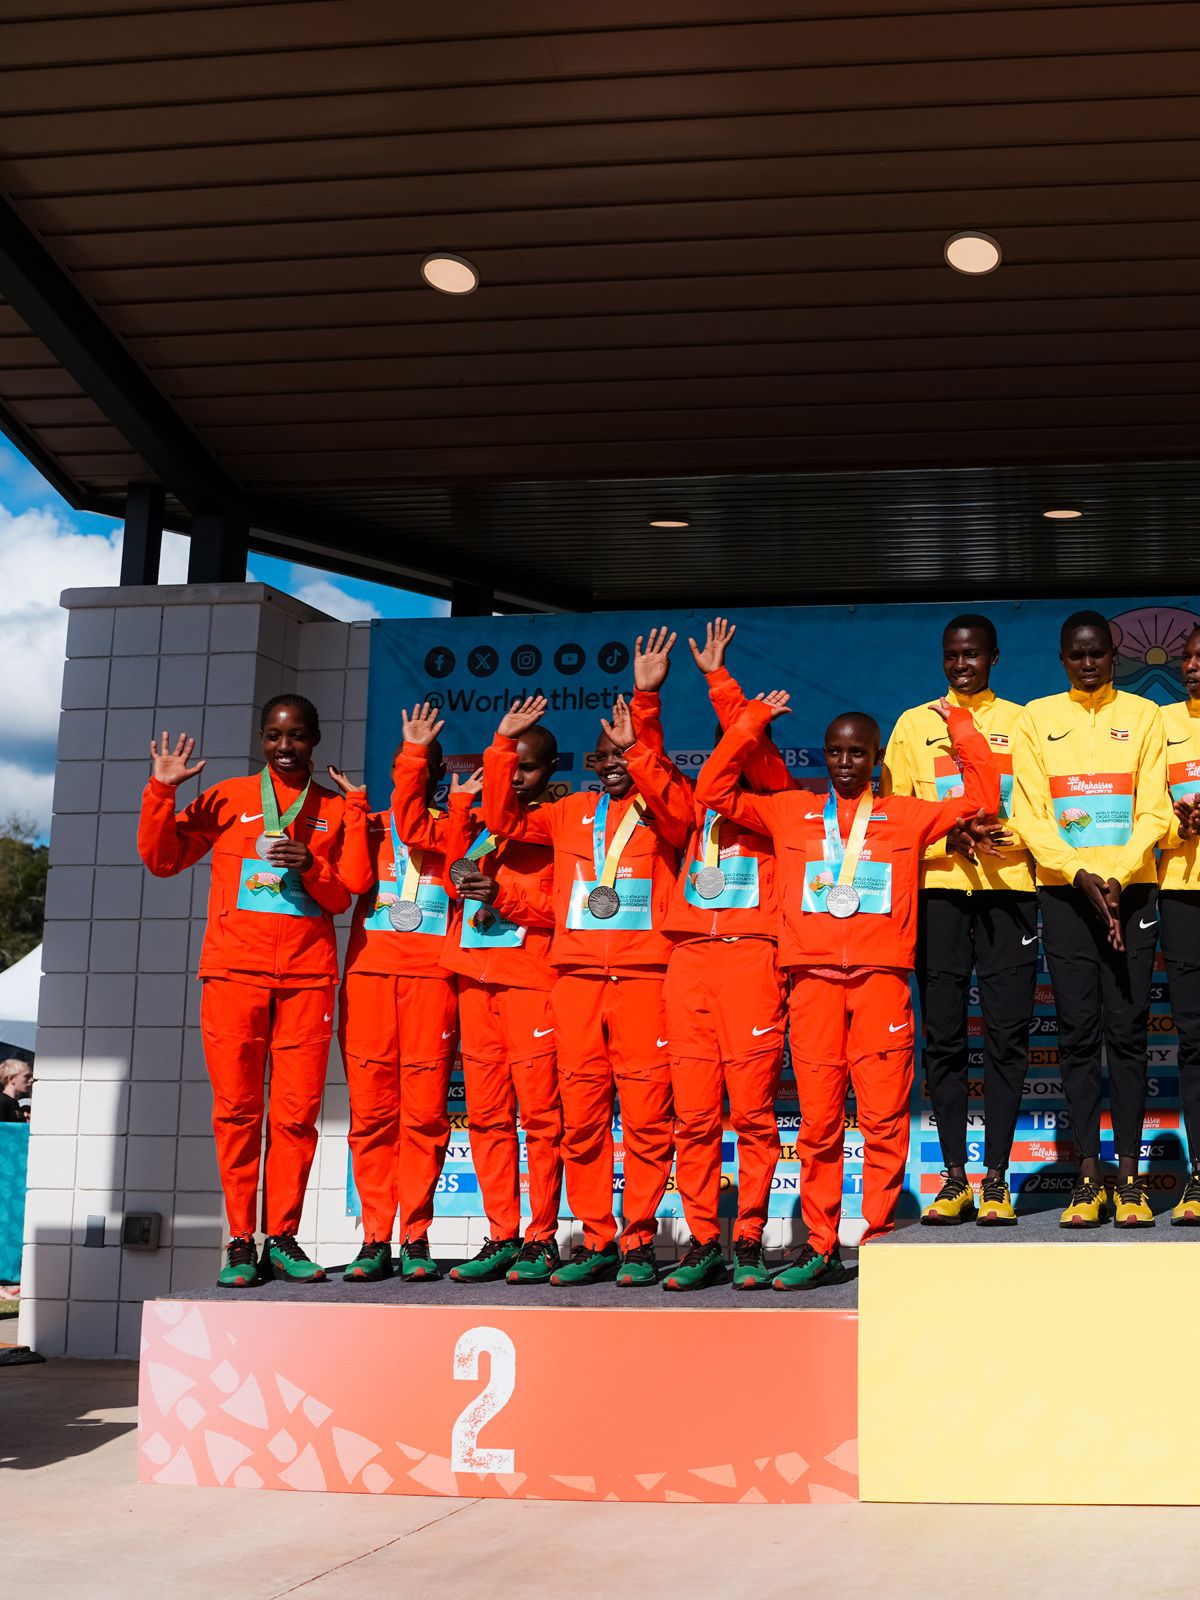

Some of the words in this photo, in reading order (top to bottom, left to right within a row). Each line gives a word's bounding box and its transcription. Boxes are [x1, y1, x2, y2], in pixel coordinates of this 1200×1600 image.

[785, 749, 810, 767] BS
[1067, 780, 1113, 792] Tallahassee
[1022, 1083, 1063, 1095] SON
[1030, 1111, 1070, 1129] TBS
[436, 1174, 459, 1193] BS
[451, 1326, 517, 1474] 2
